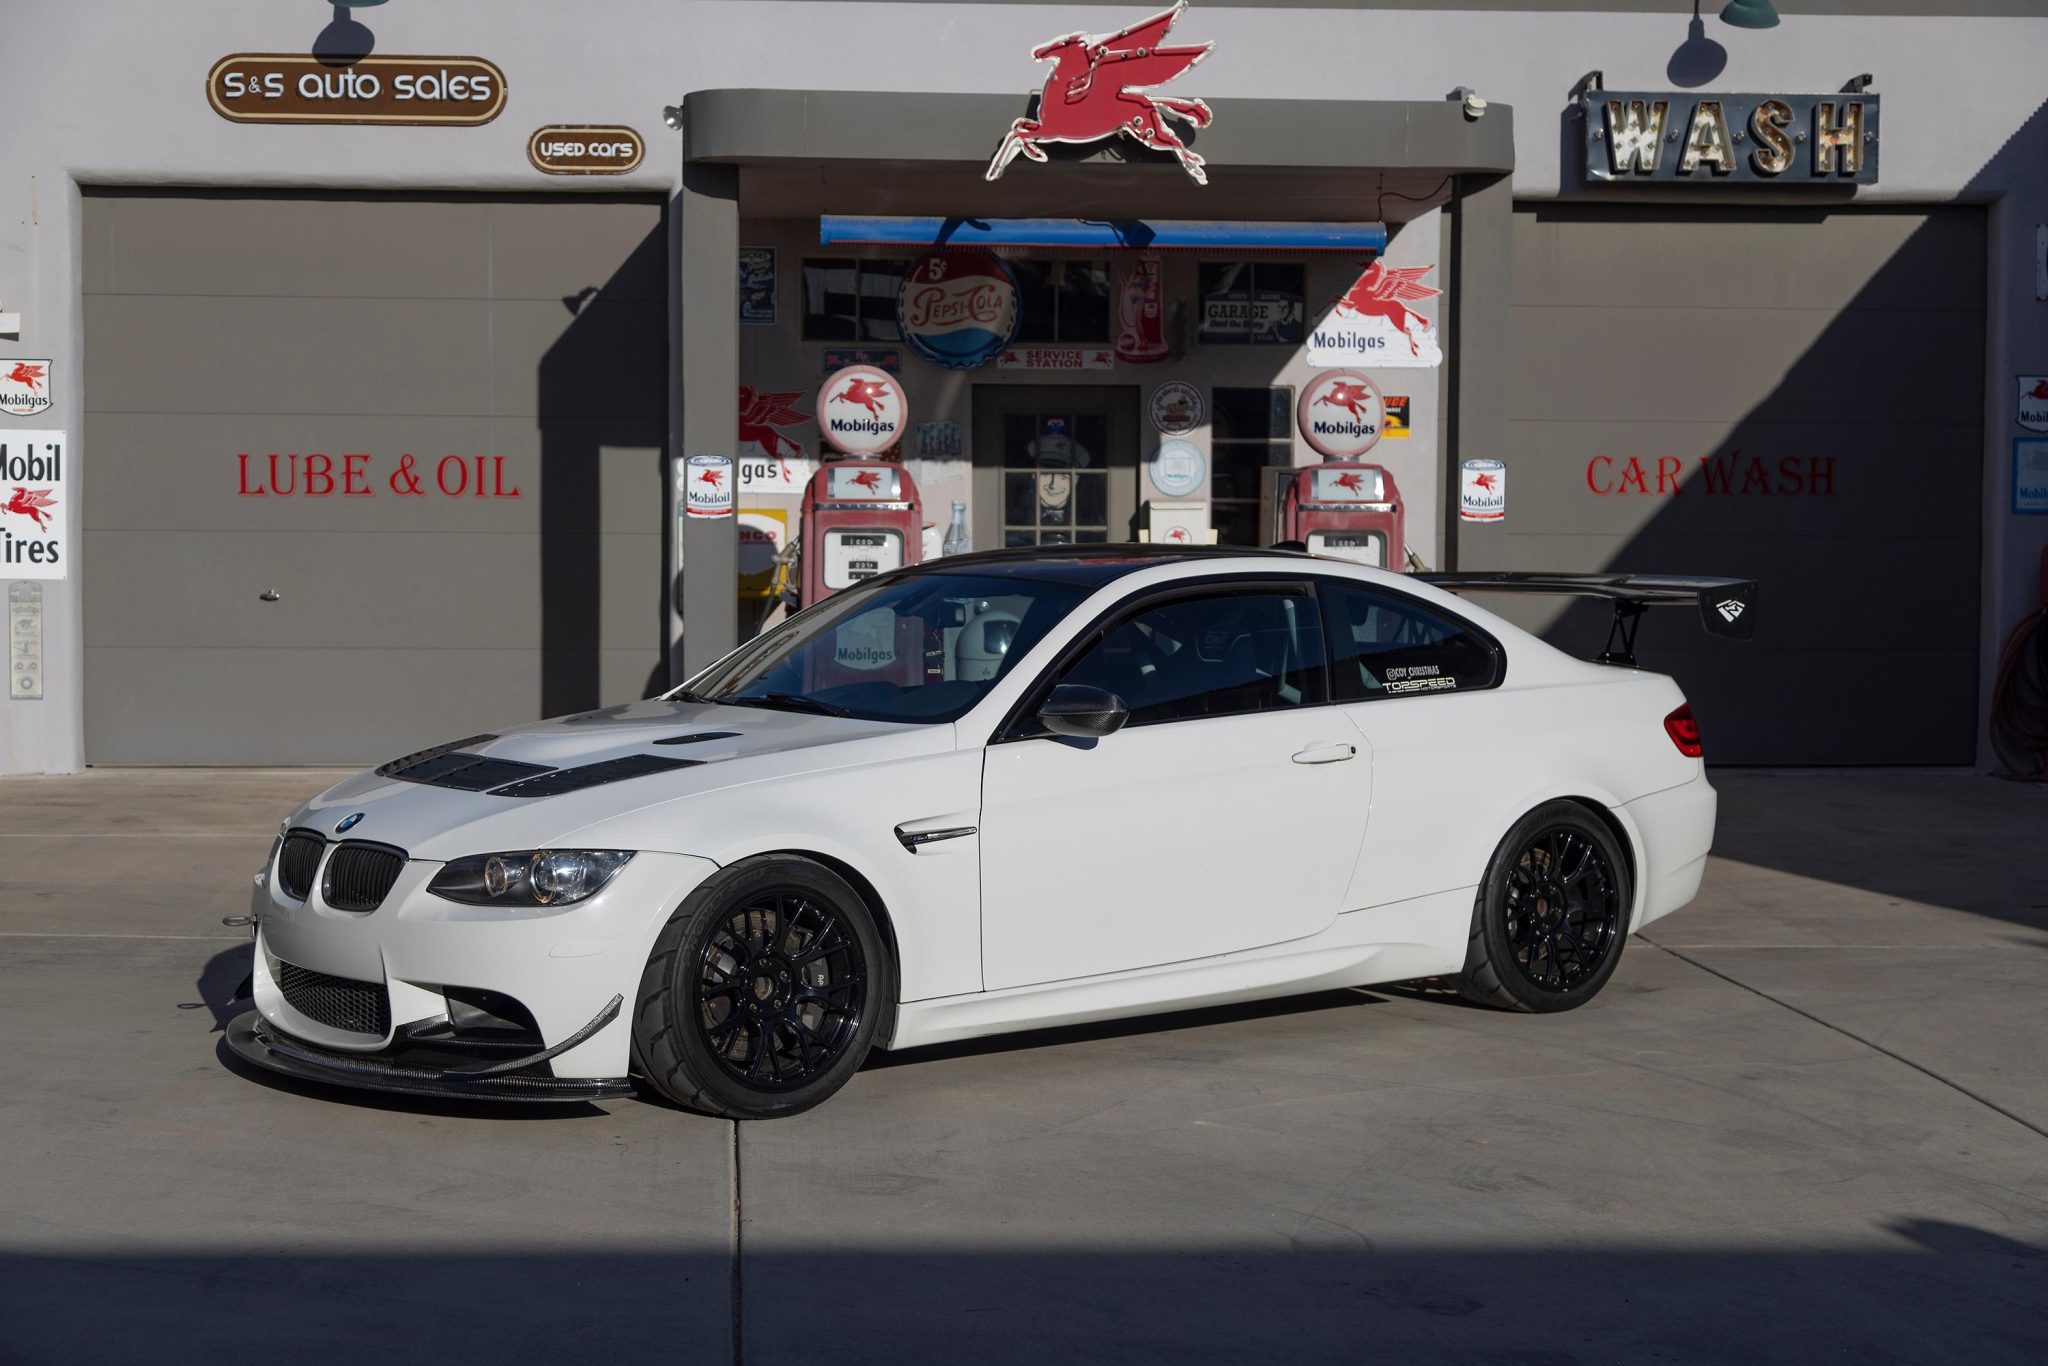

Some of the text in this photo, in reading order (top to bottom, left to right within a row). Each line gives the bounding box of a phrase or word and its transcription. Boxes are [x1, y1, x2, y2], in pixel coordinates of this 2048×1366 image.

[224, 67, 491, 101] S&S auto sales
[1604, 99, 1866, 175] WASH
[1208, 304, 1269, 319] GARAGE
[1313, 331, 1385, 353] Mobilgas
[1025, 350, 1084, 359] SERVICE
[1025, 358, 1084, 368] STATION
[830, 418, 895, 436] Mobilgas
[1313, 420, 1376, 438] Mobilgas
[237, 453, 524, 498] LUBE & OIL
[1586, 449, 1838, 498] CAR WASH
[689, 490, 731, 504] Mobiloil
[1462, 495, 1504, 508] Mobiloil
[837, 646, 894, 663] Mobilgas
